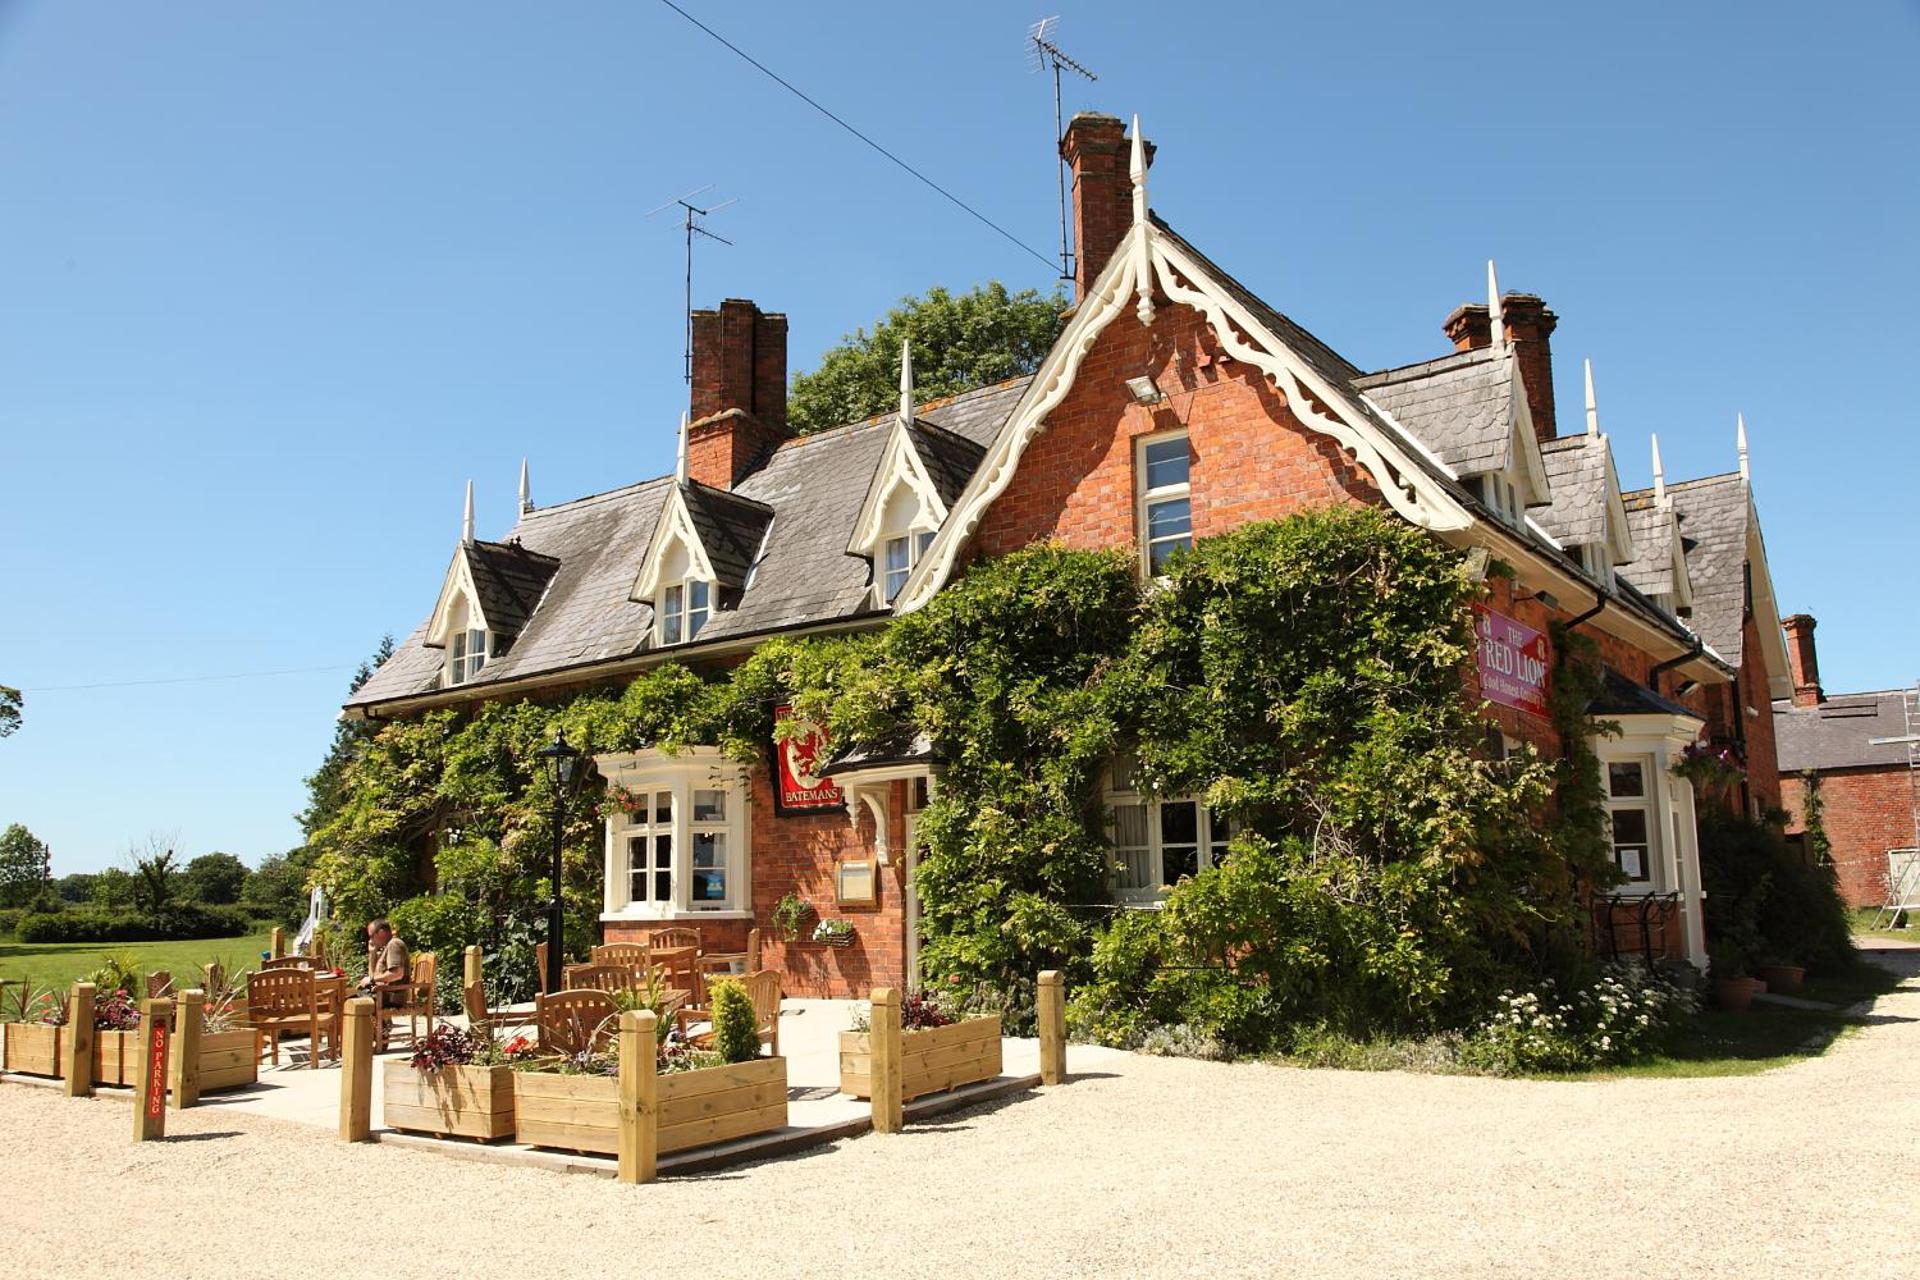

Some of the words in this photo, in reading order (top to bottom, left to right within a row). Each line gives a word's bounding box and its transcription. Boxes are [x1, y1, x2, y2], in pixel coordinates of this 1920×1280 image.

[1507, 625, 1523, 648] THE
[1485, 638, 1513, 675] RED
[1516, 651, 1546, 688] LION
[785, 788, 838, 802] BATEMANS
[155, 1030, 164, 1048] NO
[151, 1052, 163, 1114] PARKING
